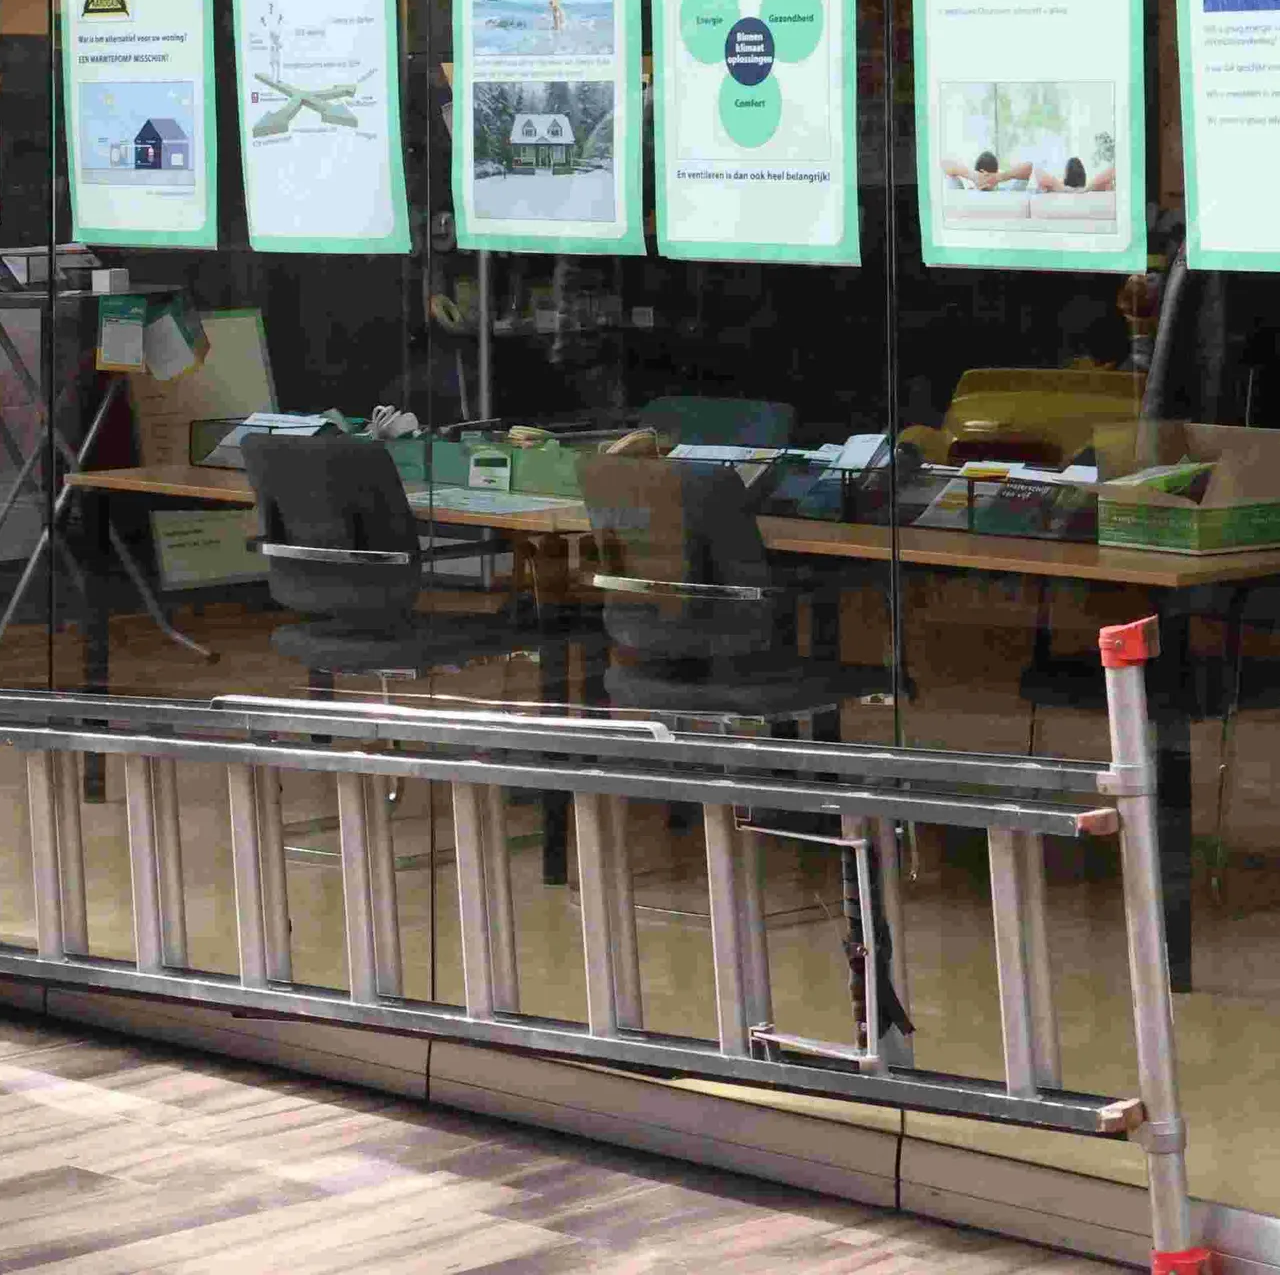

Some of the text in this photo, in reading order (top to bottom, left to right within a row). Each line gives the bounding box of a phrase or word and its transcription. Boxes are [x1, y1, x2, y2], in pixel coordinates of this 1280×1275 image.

[768, 13, 815, 23] Gezondheid
[161, 33, 188, 43] woning?
[736, 32, 764, 42] Binnen
[735, 43, 765, 53] klimaat
[78, 55, 89, 63] EEN
[90, 54, 132, 63] WARMTEPOMP
[727, 54, 773, 66] oplossingen
[734, 98, 766, 108] Comfort
[676, 170, 686, 179] En
[687, 170, 724, 180] ventileren
[733, 170, 749, 180] dan
[749, 170, 765, 180] ook
[767, 170, 784, 181] heel
[786, 170, 831, 183] belangrijk!
